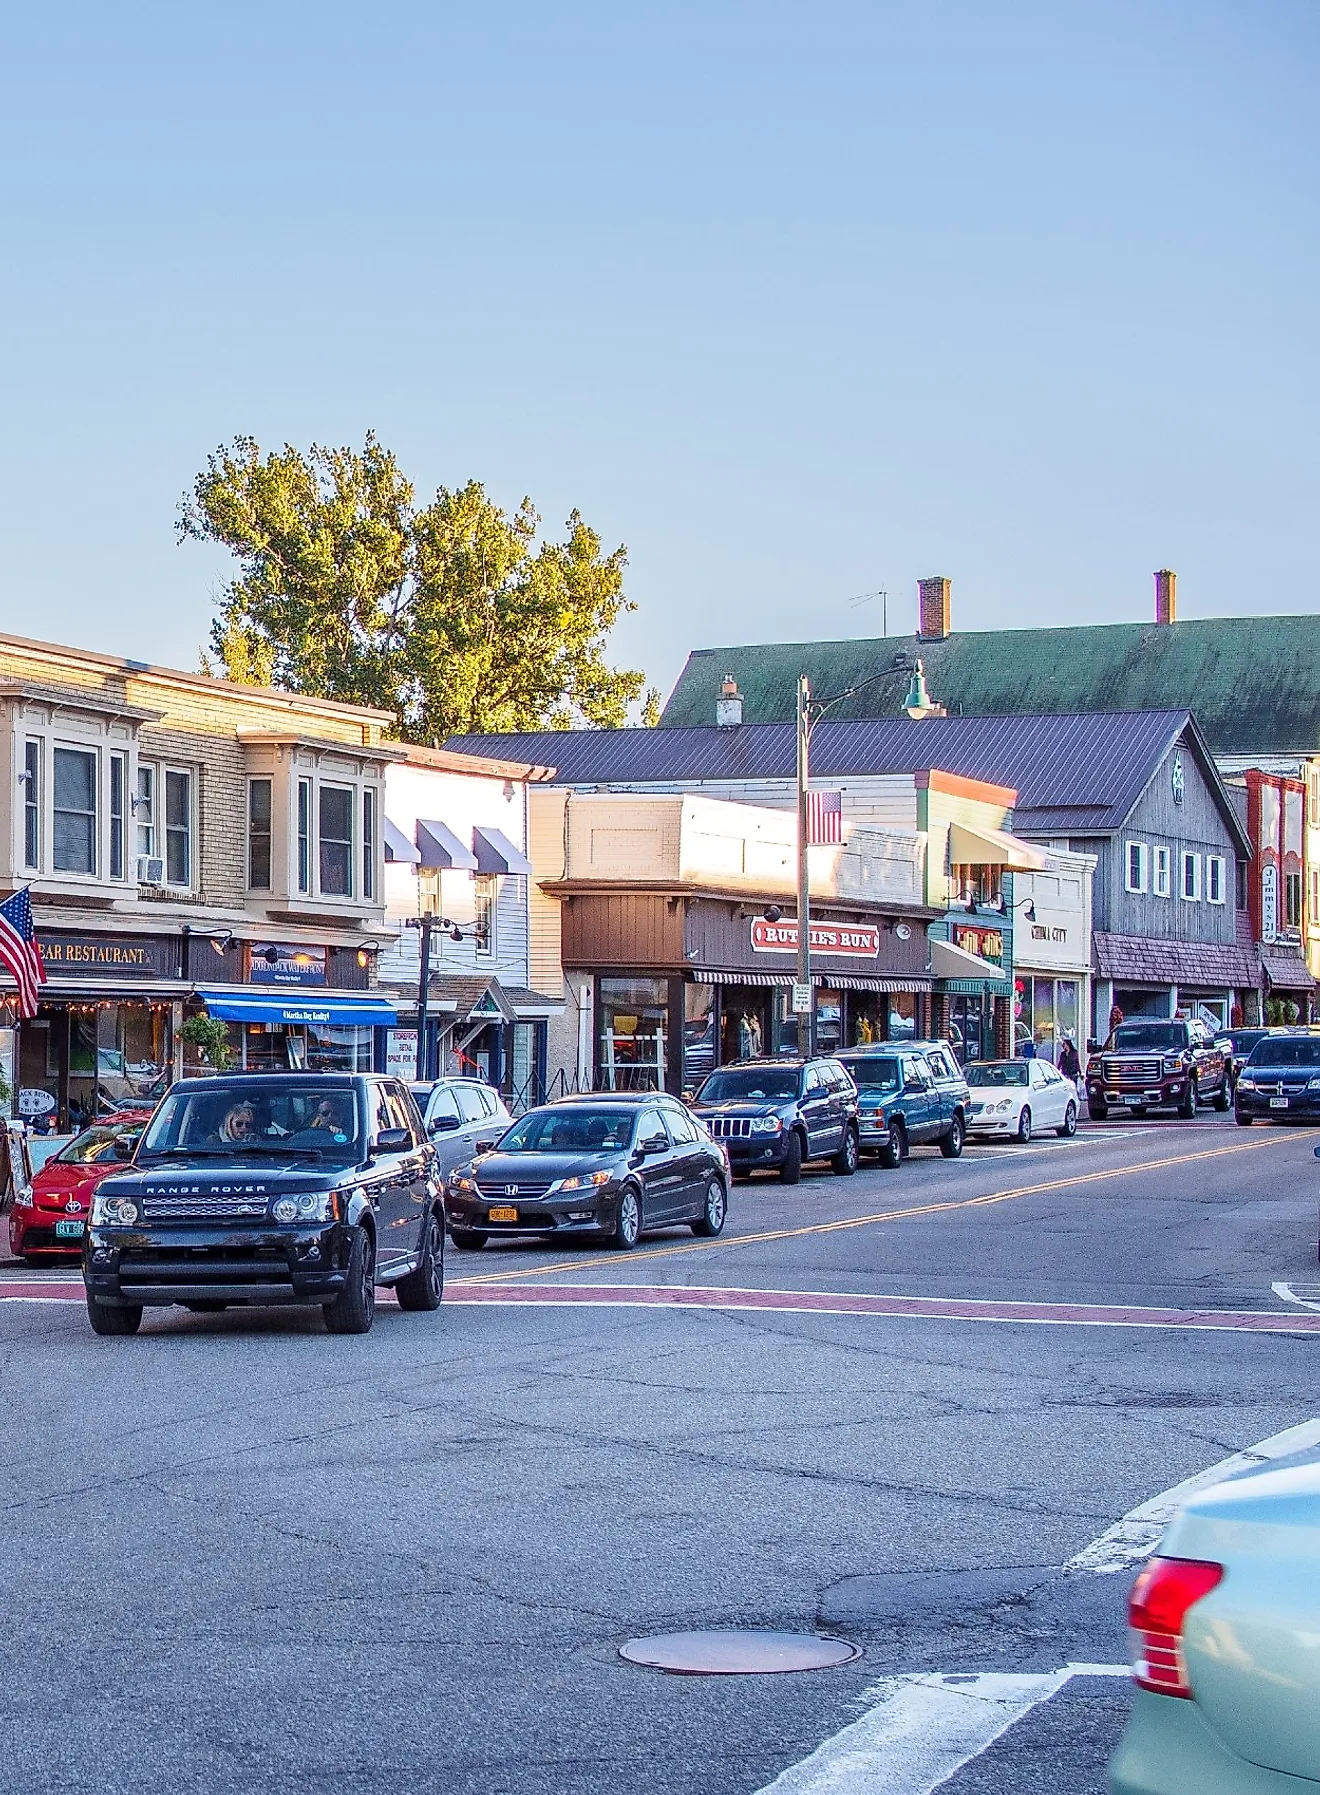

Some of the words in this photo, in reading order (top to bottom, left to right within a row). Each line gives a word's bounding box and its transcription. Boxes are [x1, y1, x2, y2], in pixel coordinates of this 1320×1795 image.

[765, 928, 837, 946] RUTIE'S
[840, 933, 871, 948] RUN
[39, 944, 62, 960] EAR
[66, 946, 145, 964] RESTAURANT
[392, 1032, 418, 1041] STOREFRON
[387, 1054, 401, 1063] SPACE
[402, 1054, 411, 1063] FOR
[146, 1186, 200, 1194] RANGE
[211, 1185, 266, 1193] ROVER
